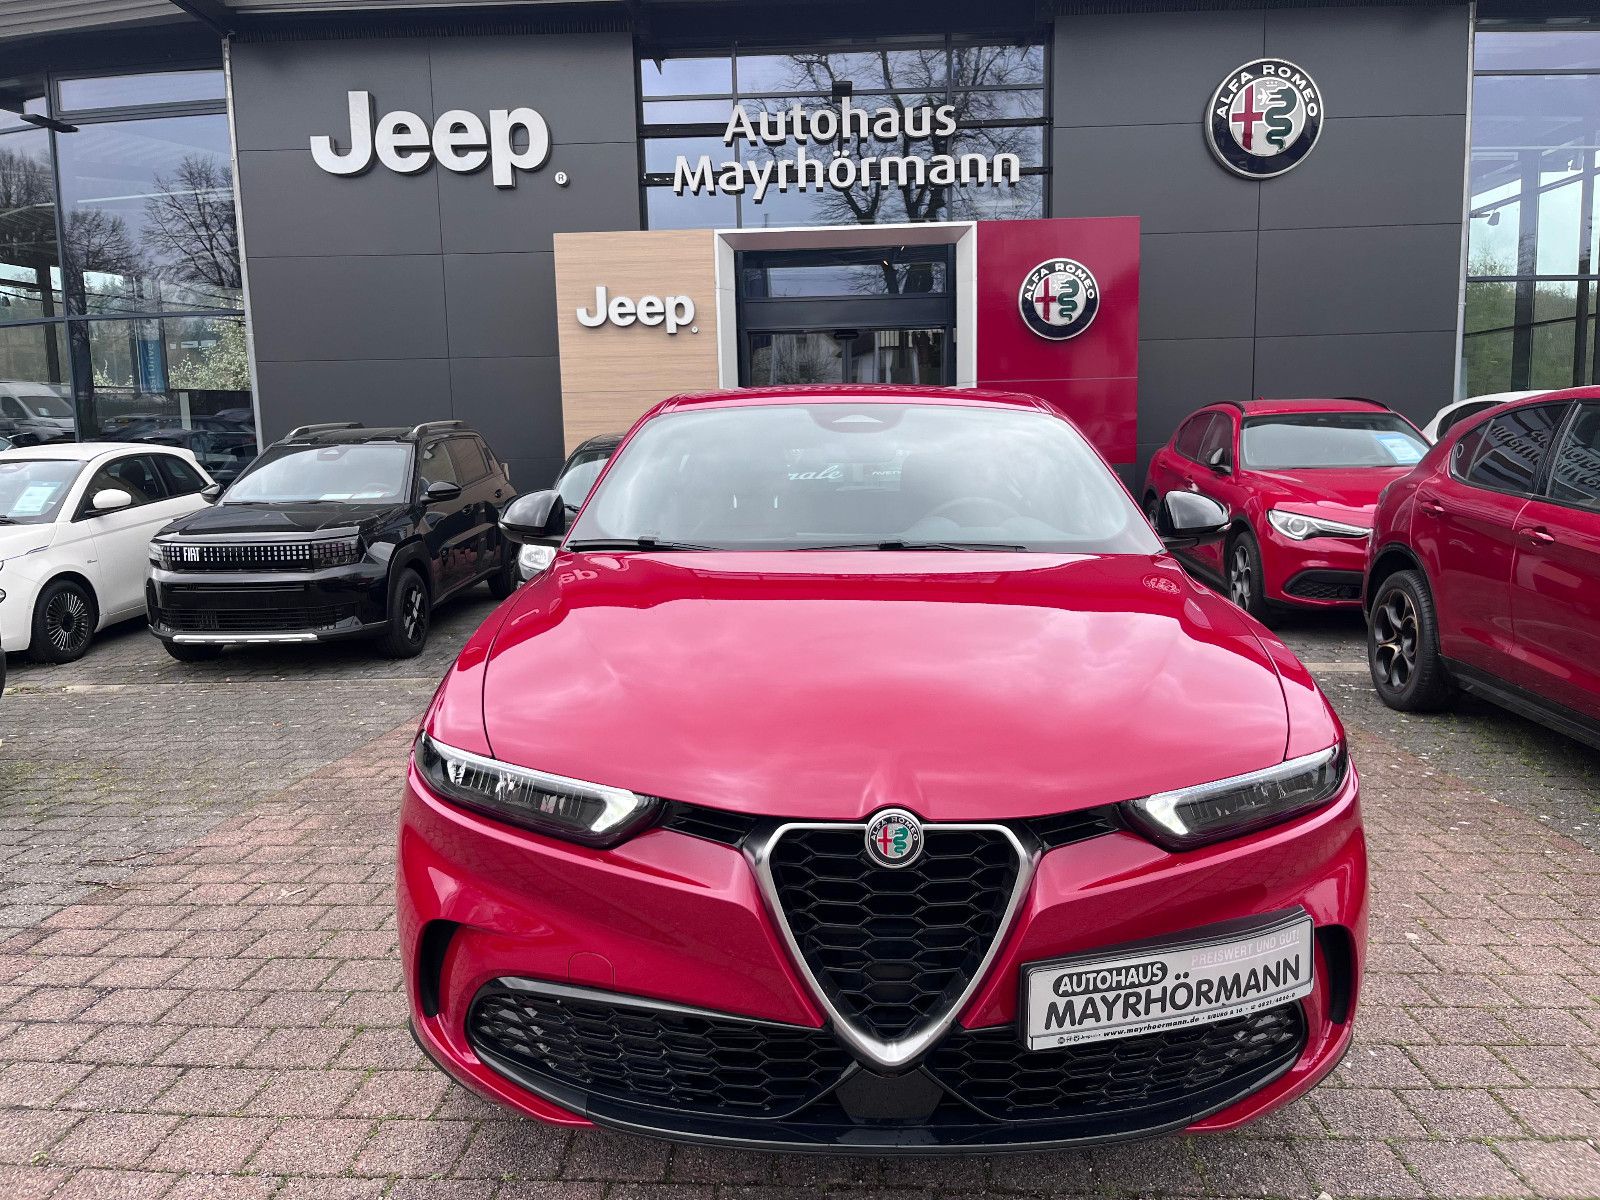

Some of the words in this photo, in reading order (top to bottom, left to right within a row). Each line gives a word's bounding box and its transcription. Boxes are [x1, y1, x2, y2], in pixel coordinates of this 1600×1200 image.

[1216, 71, 1254, 119] ALFA
[1262, 64, 1318, 117] ROMEO
[309, 90, 550, 187] Jeep
[722, 97, 957, 144] Autohaus
[672, 146, 1020, 203] Mayrhörmann
[1024, 267, 1050, 300] ALFA
[1054, 263, 1095, 299] ROMEO
[576, 286, 695, 334] Jeep
[183, 546, 200, 562] FIAT
[871, 819, 888, 841] ALFA
[891, 816, 919, 841] ROMEO
[1191, 943, 1253, 967] PREISWERT
[1256, 936, 1276, 952] UND
[1279, 929, 1300, 944] GUT!
[1044, 953, 1300, 1030] MAYRHÖRMANN
[1058, 963, 1162, 994] AUTOHAUS
[1103, 1016, 1200, 1037] www.mayrhoermann.de
